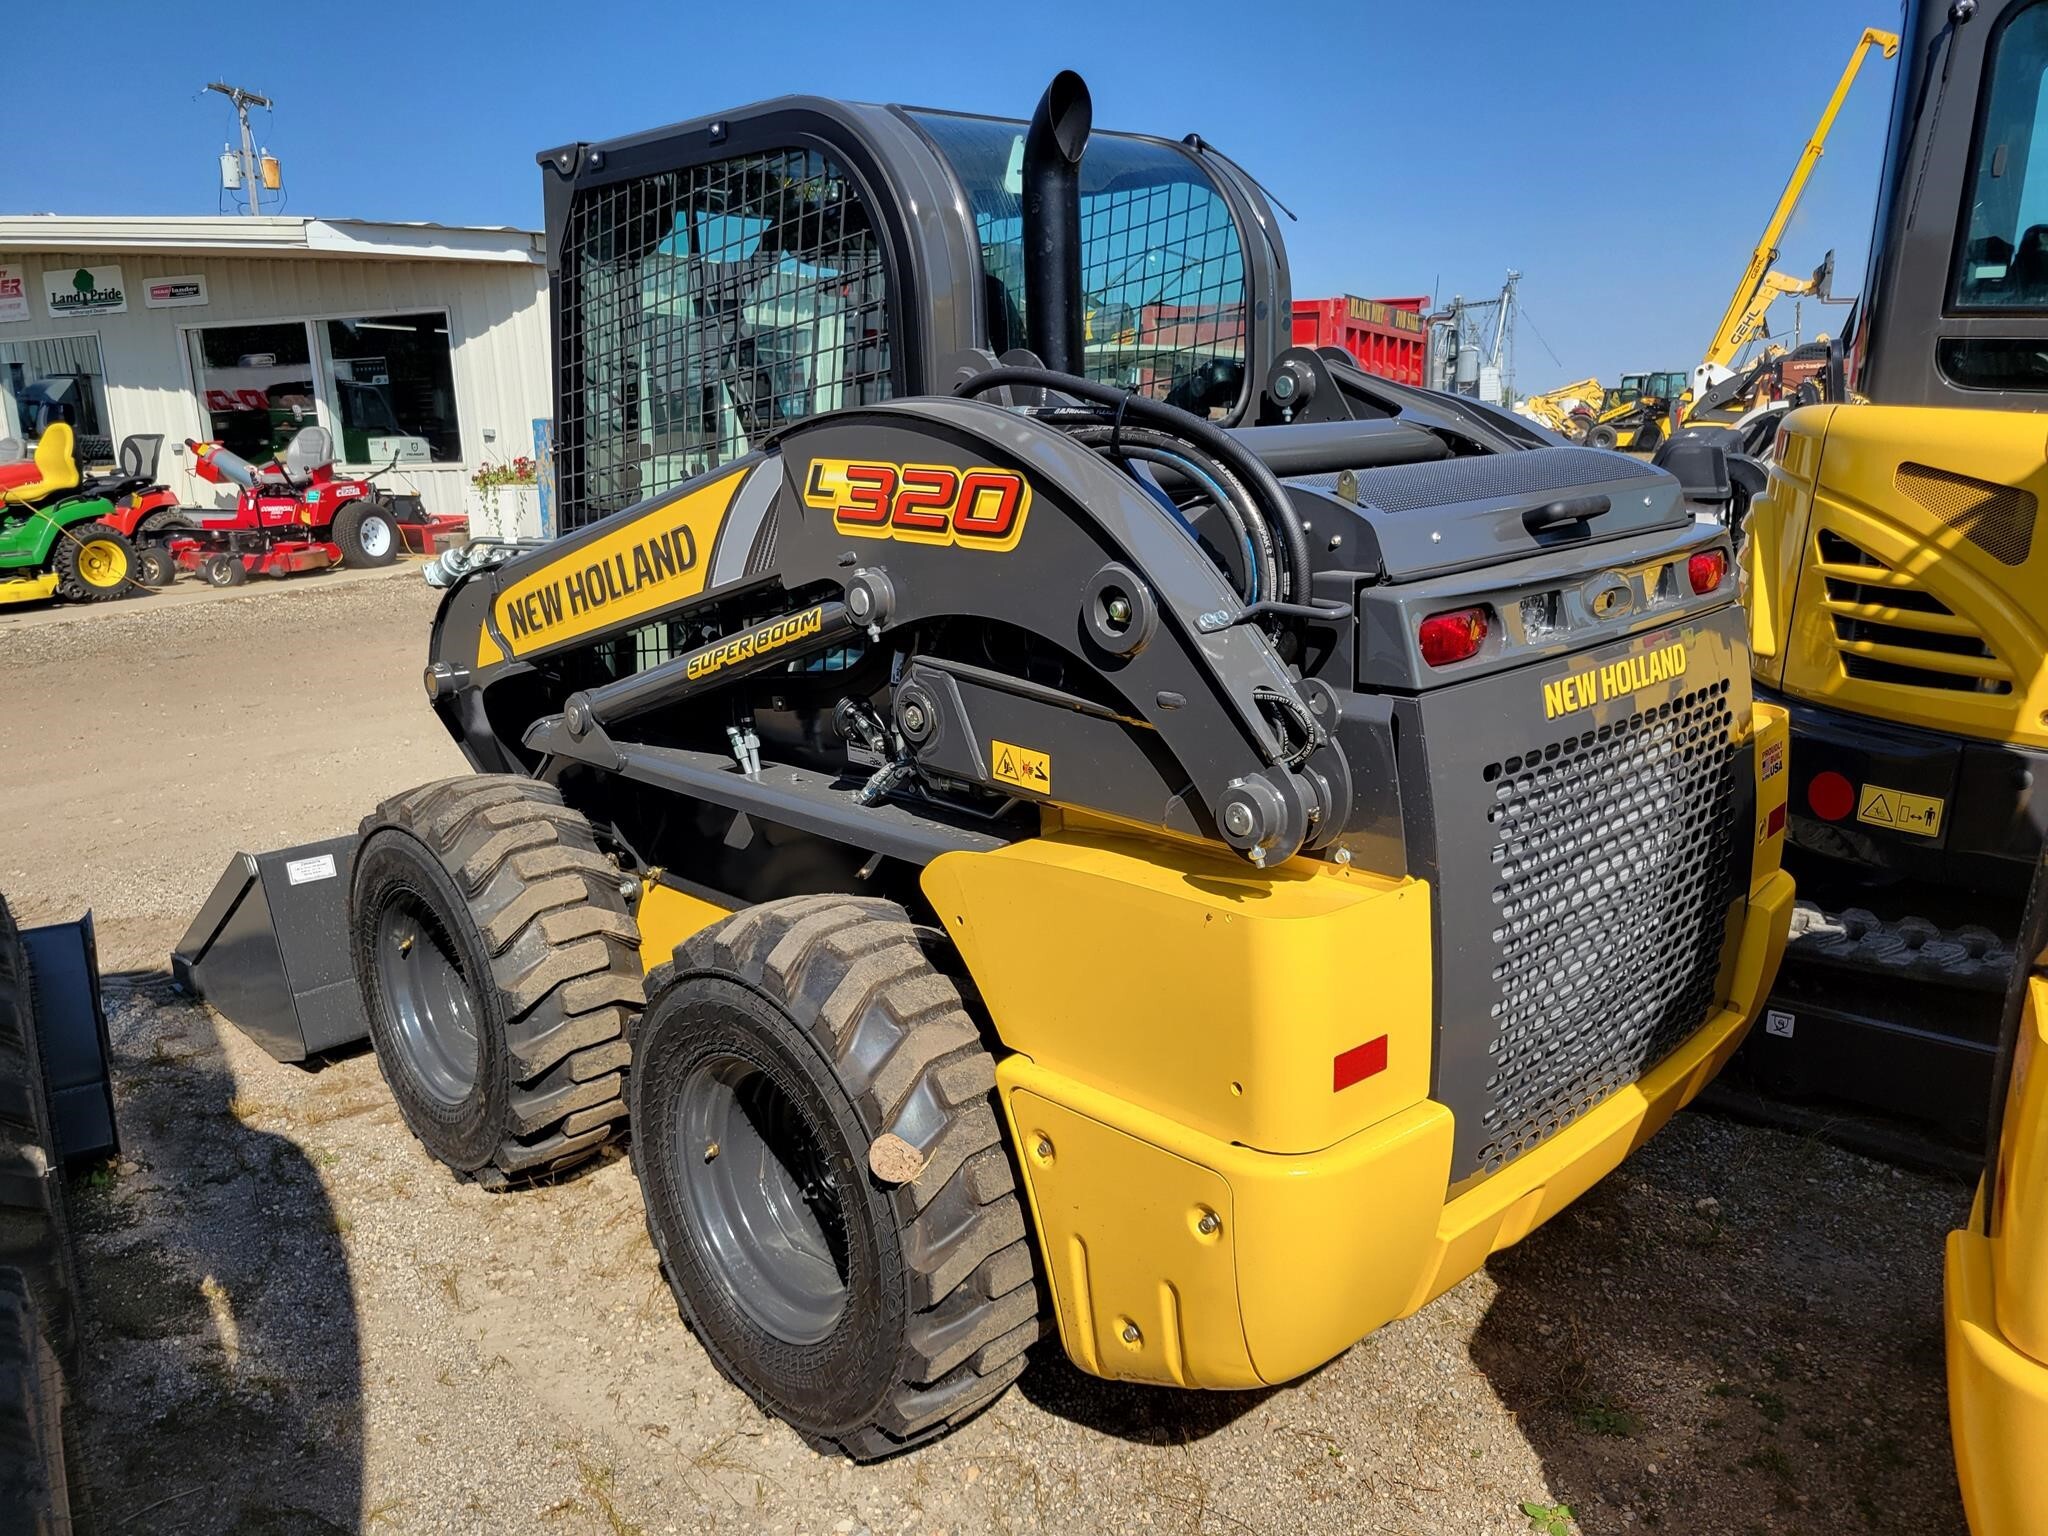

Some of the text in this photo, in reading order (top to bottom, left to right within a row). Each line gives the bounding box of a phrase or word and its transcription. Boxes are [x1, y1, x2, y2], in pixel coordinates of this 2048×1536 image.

[1750, 257, 1765, 280] GEHL
[51, 287, 122, 305] Land Pride
[1730, 308, 1761, 345] GEHL
[507, 524, 698, 642] NEW HOLLAND
[688, 607, 822, 680] SUPER BOOM
[1543, 643, 1688, 720] NEW HOLLAND
[1762, 740, 1783, 760] PROUDLY
[1770, 760, 1783, 777] USA
